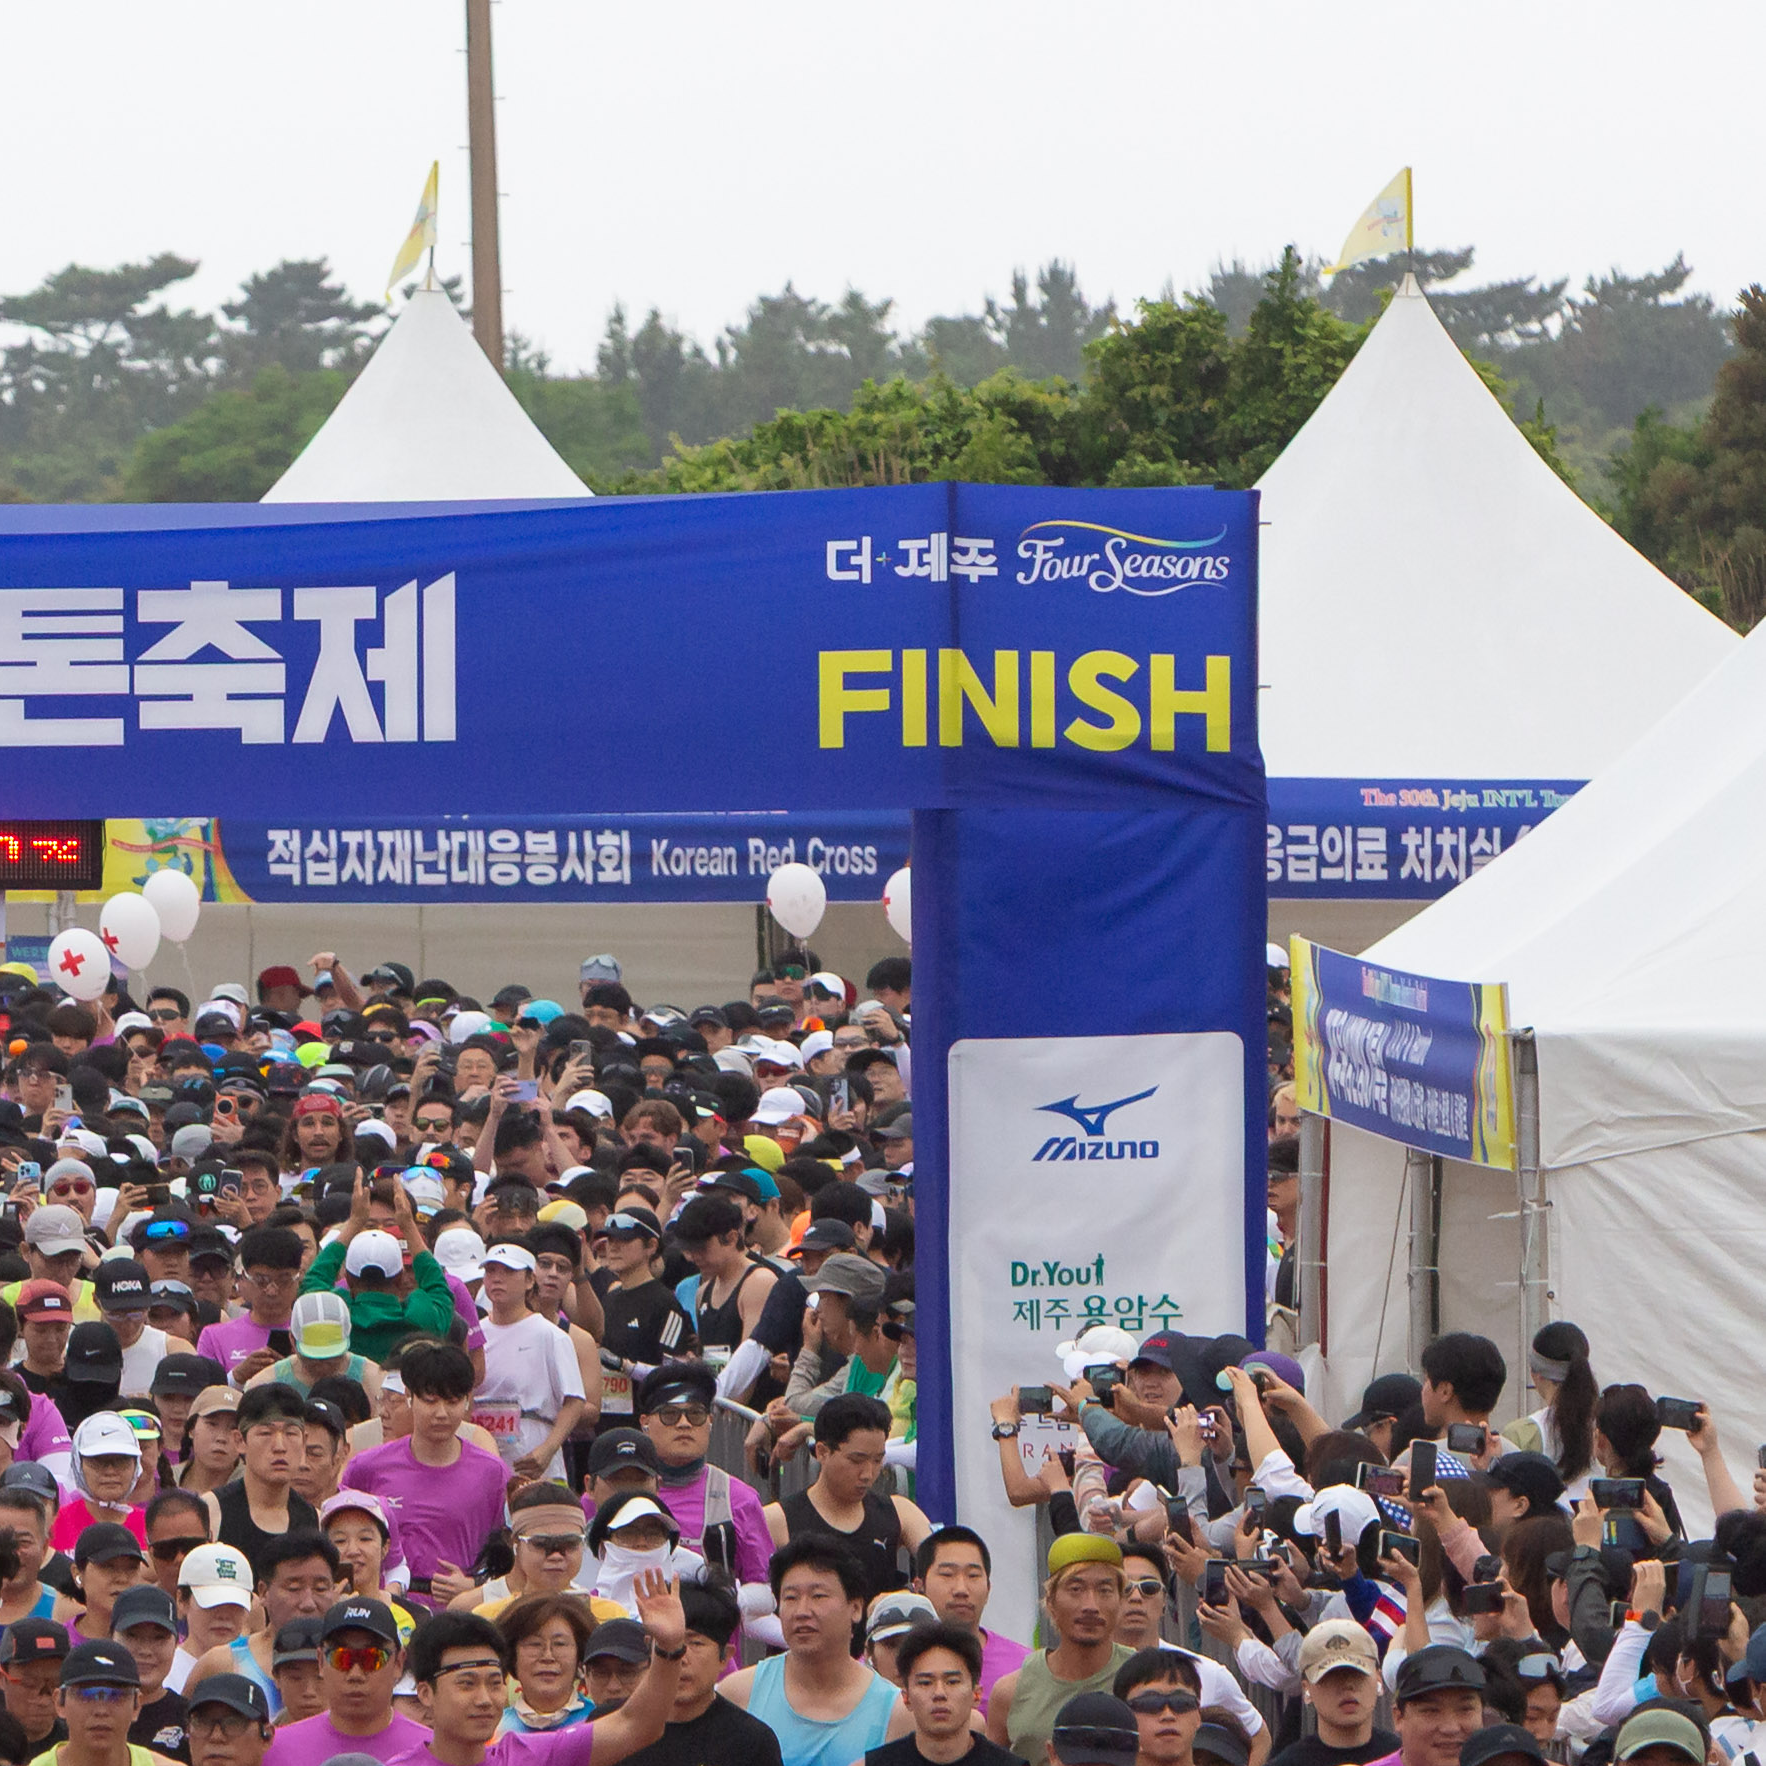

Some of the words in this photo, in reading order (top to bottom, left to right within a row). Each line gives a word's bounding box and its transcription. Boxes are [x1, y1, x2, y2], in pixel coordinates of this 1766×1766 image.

[826, 534, 872, 584] 더
[895, 532, 998, 584] 제주
[1017, 534, 1101, 587] Four
[1088, 538, 1230, 595] Seasons
[818, 648, 1231, 753] FINISH
[267, 828, 632, 886] 적십자재난대응봉사회
[651, 839, 738, 877] Korean
[748, 839, 795, 877] Red
[807, 839, 878, 877] Cross
